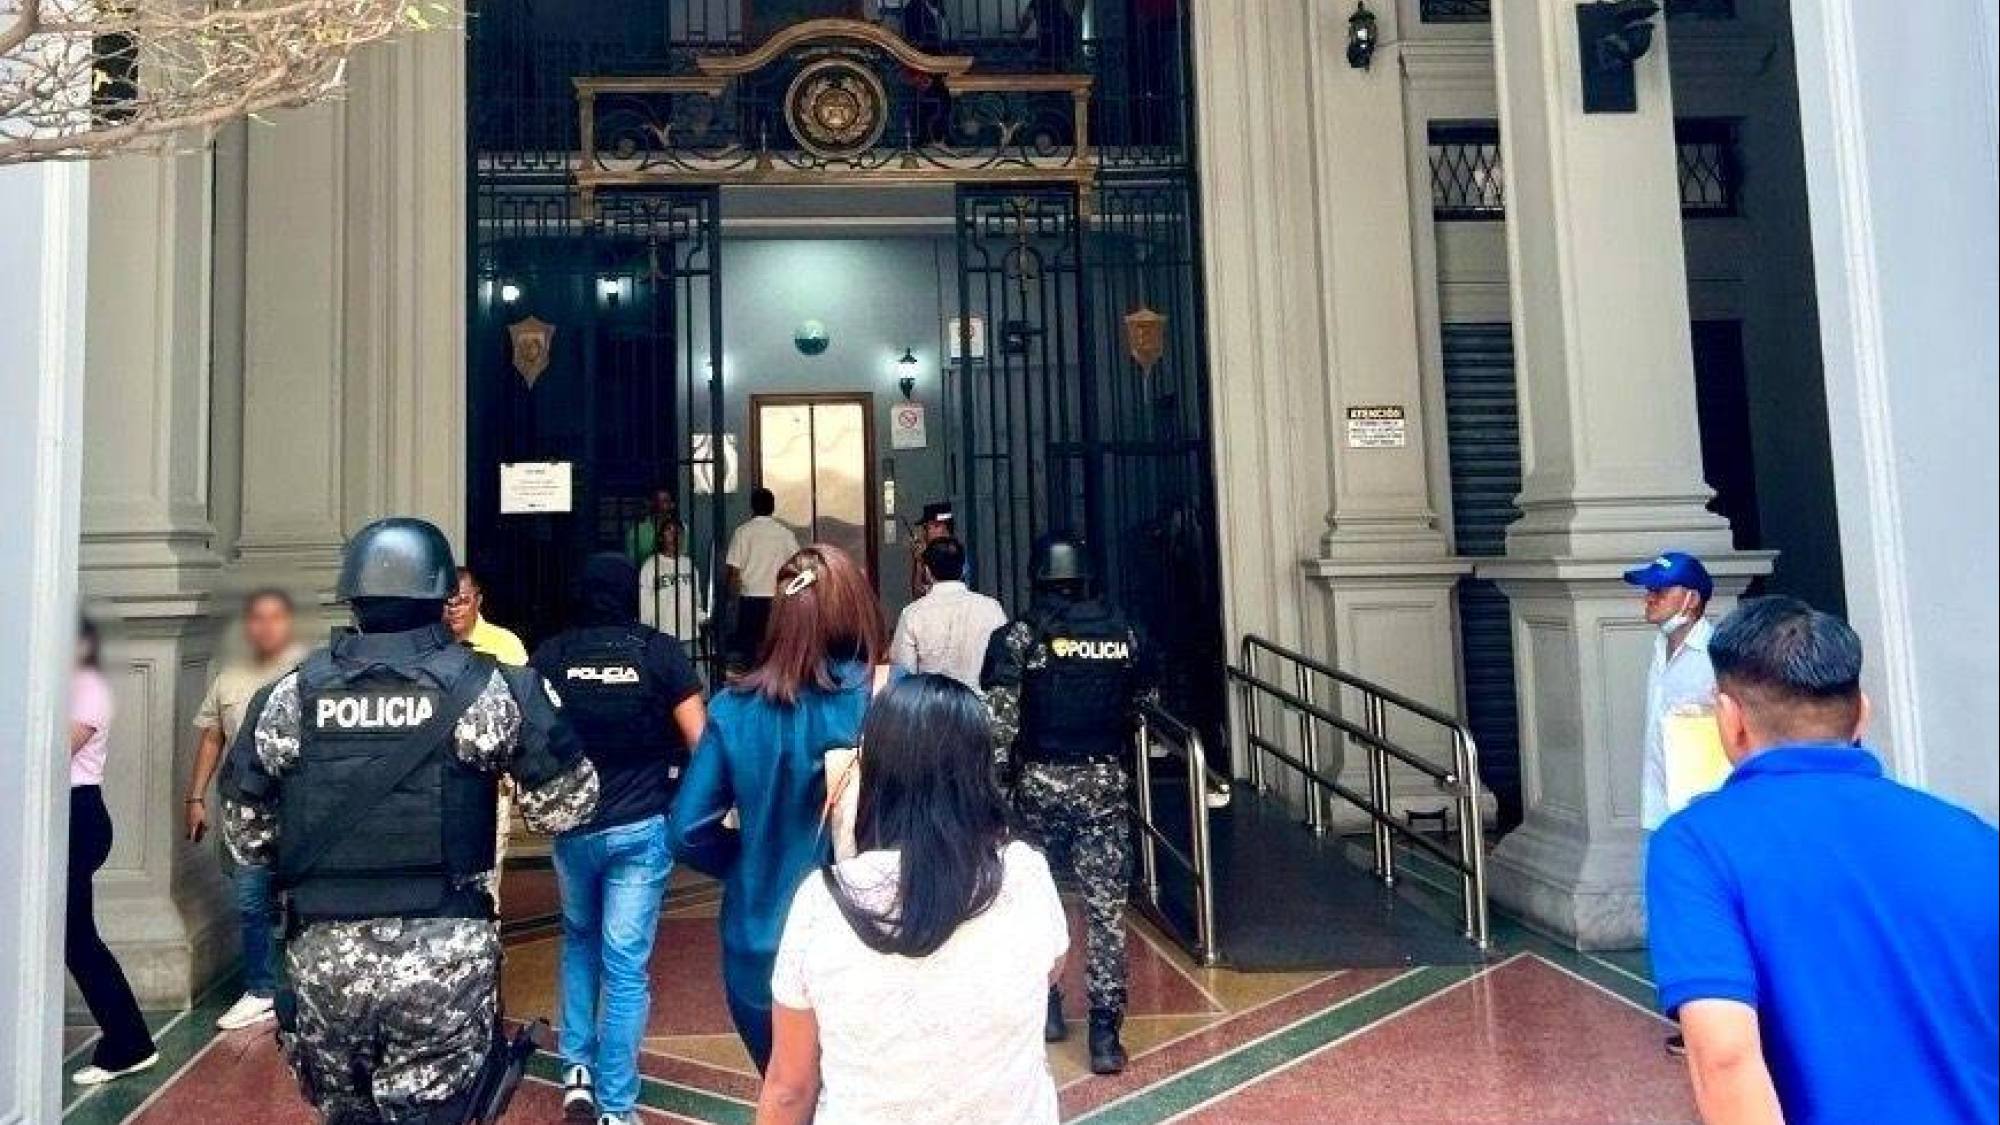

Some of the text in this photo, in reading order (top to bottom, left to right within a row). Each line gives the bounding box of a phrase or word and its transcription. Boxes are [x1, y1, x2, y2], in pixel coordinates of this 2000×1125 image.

[1067, 640, 1129, 658] POLICIA
[567, 667, 639, 680] POLICIA
[316, 697, 433, 727] POLICIA
